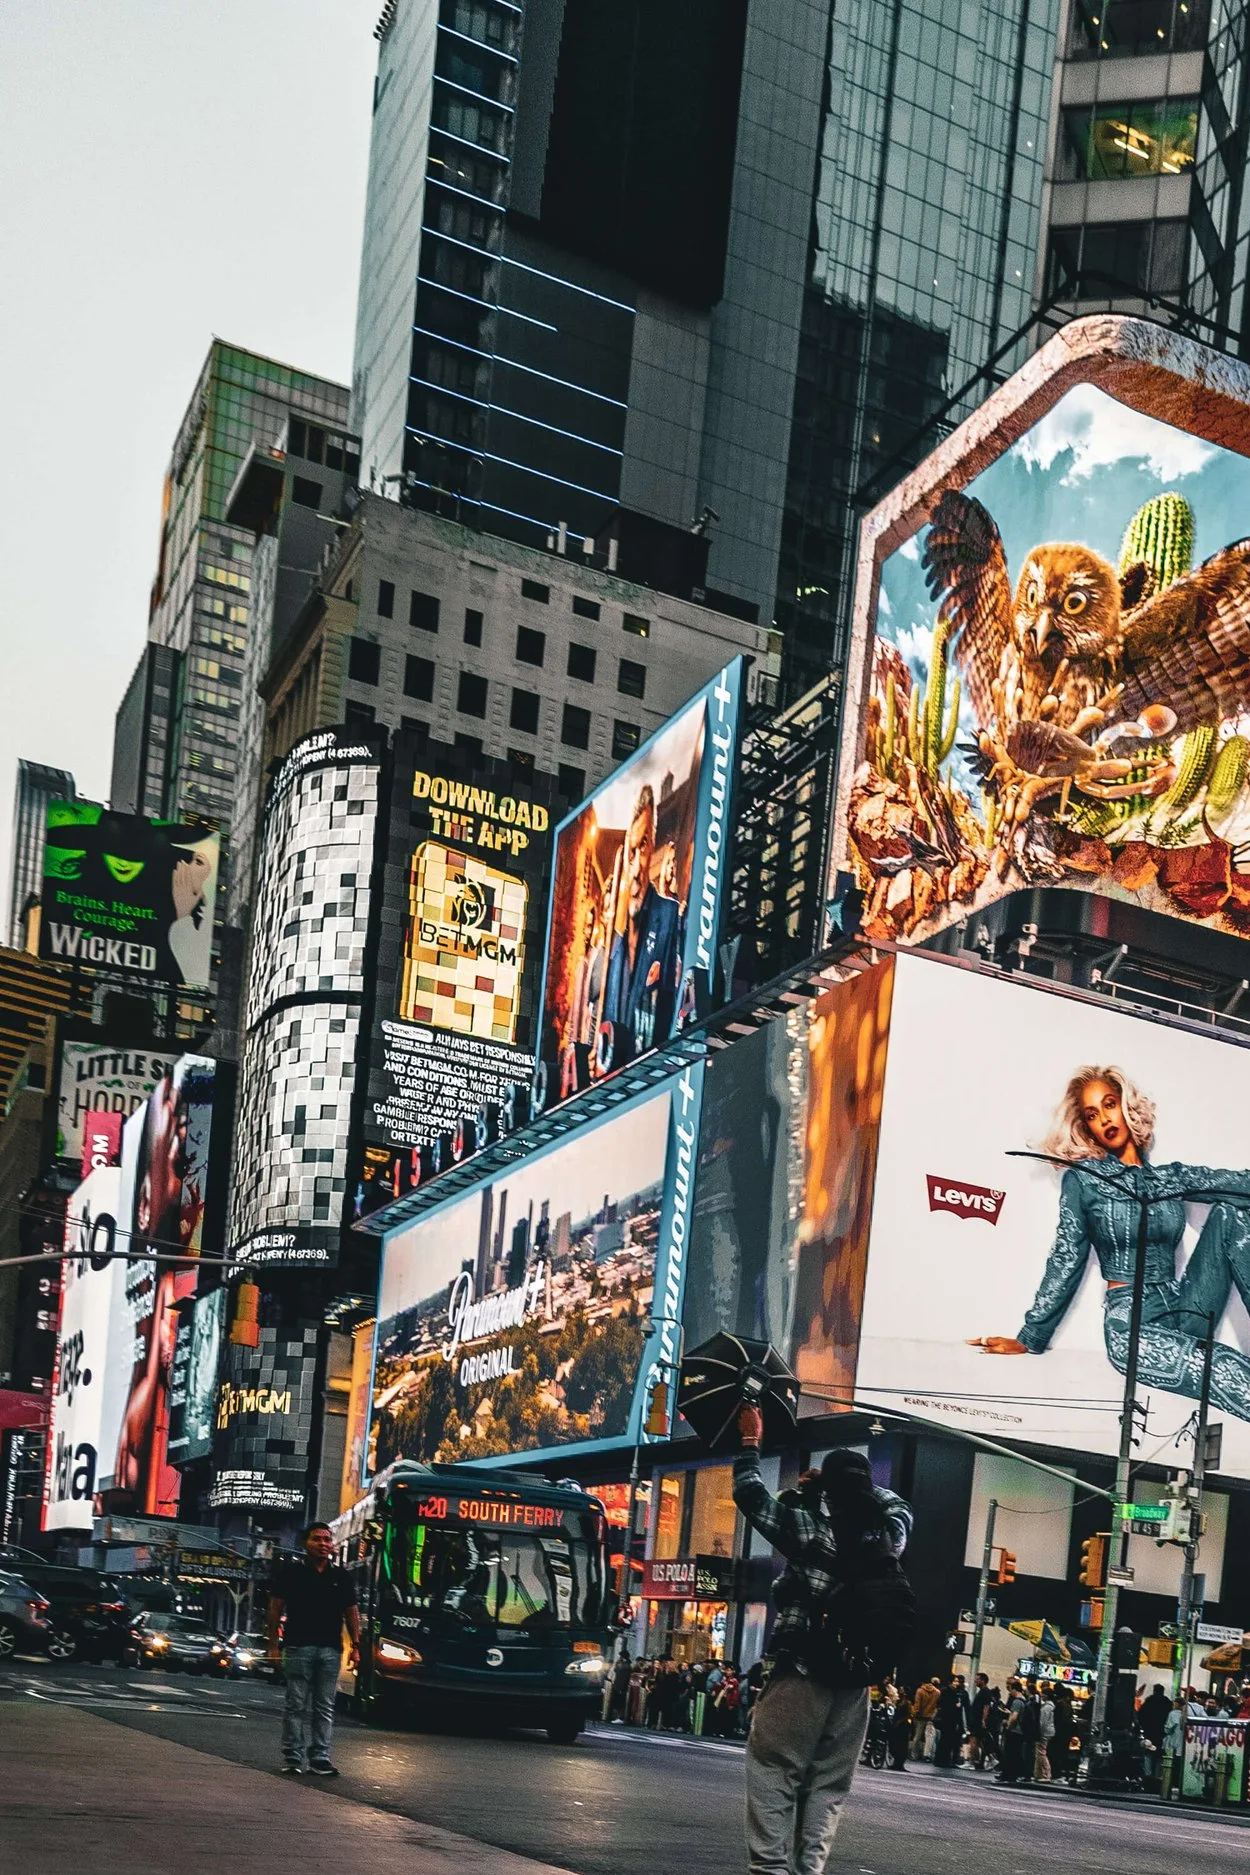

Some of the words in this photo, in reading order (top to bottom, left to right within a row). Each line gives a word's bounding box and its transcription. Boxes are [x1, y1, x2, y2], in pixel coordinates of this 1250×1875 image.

[412, 770, 549, 832] DOWNLOAD
[429, 805, 474, 844] THE
[477, 821, 530, 856] APP
[56, 889, 109, 912] Brains.
[111, 901, 158, 920] Heart.
[73, 907, 139, 932] Courage.
[419, 921, 517, 967] BETMGM
[470, 1041, 485, 1053] BET
[76, 1053, 147, 1083] LITTLE
[383, 1061, 407, 1075] AND
[393, 1074, 424, 1089] YEARS
[425, 1081, 440, 1093] OF
[479, 1073, 499, 1085] FOR
[437, 1095, 458, 1109] AND
[390, 1130, 406, 1141] OR
[442, 1260, 546, 1361] Paramount+
[461, 1345, 514, 1388] ORIGINAL
[930, 1401, 941, 1410] THE
[418, 1496, 448, 1519] M20
[458, 1499, 511, 1524] SOUTH
[513, 1503, 565, 1528] FERRY
[1134, 1506, 1167, 1520] Broadway
[1142, 1523, 1153, 1535] 45
[392, 1615, 421, 1629] 7607
[1185, 1725, 1246, 1748] CHICAGO
